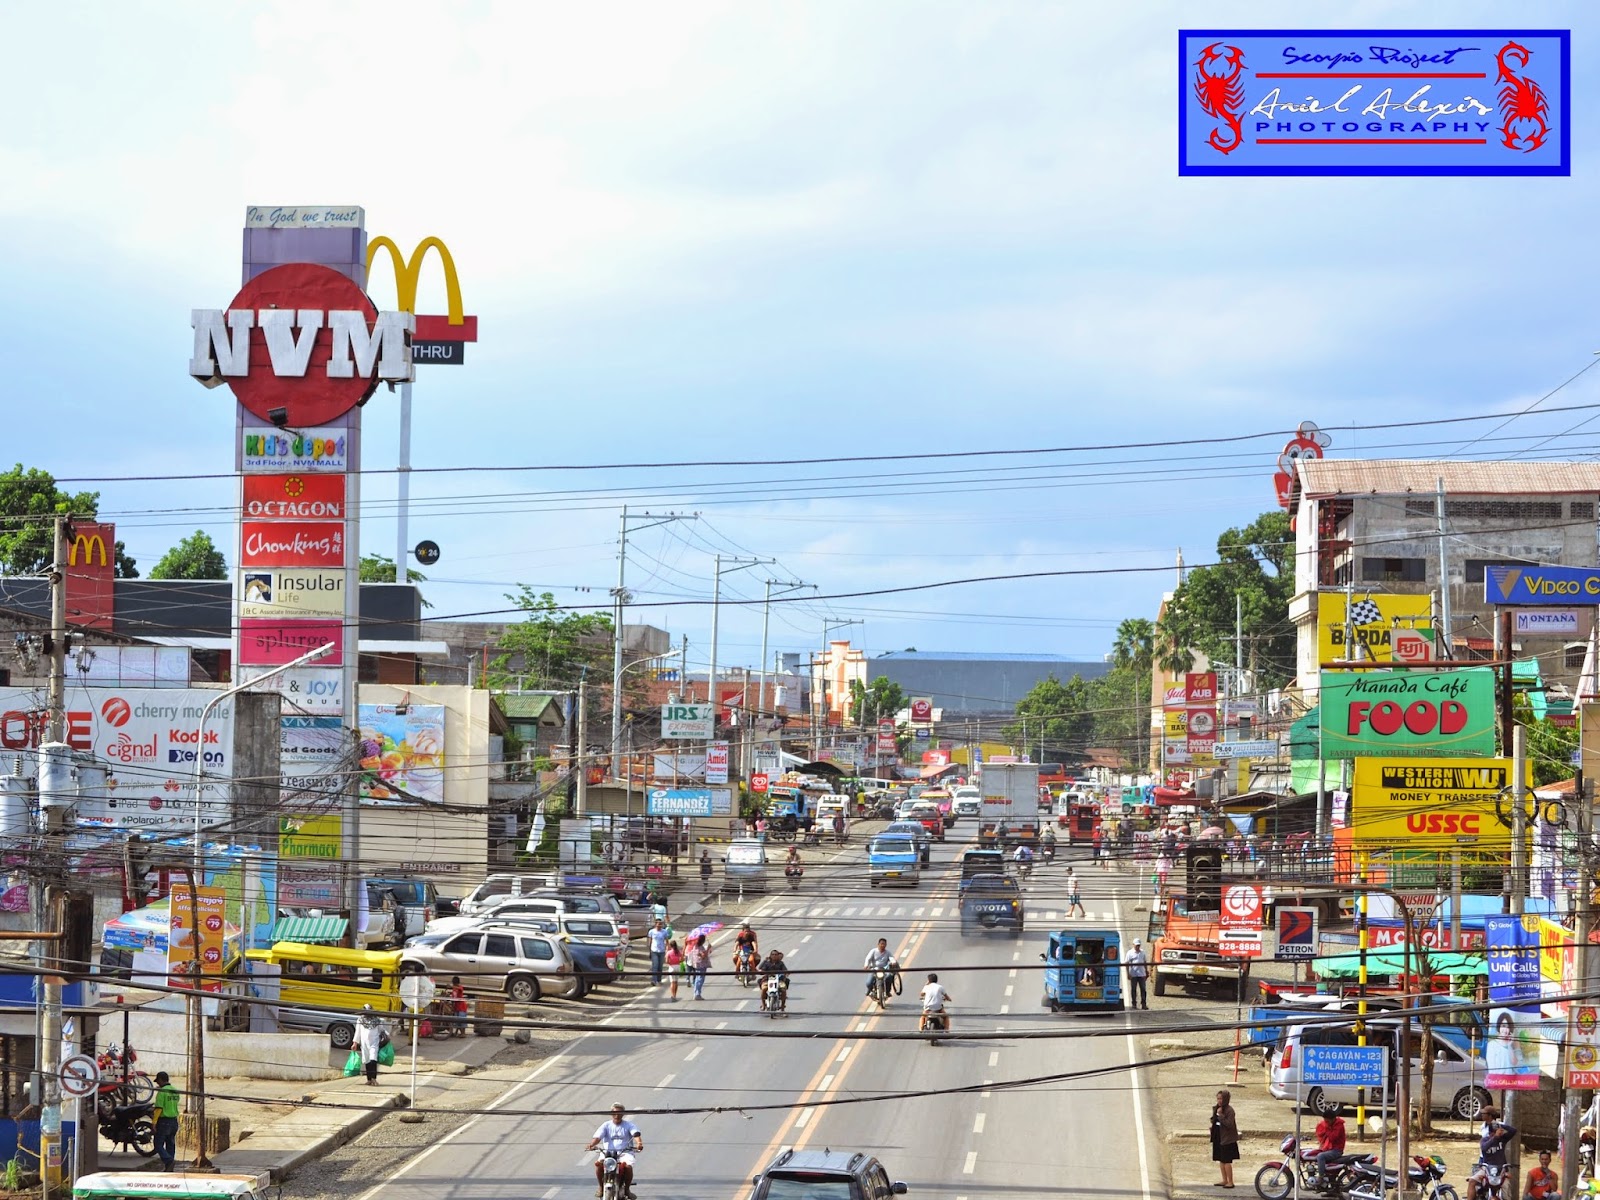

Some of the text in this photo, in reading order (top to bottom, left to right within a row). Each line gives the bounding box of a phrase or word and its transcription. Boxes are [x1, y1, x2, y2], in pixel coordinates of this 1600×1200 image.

[248, 207, 357, 228] In God we trust
[190, 309, 413, 378] NVM
[411, 345, 453, 358] THRU
[245, 435, 345, 460] Kid's depot
[248, 501, 340, 516] OCTAGON
[246, 532, 330, 556] Chowking
[278, 573, 344, 591] Insular
[278, 592, 300, 603] Life
[256, 629, 329, 653] splurge
[290, 680, 300, 692] &
[306, 681, 338, 696] JOY
[1190, 688, 1212, 698] AUB
[1345, 677, 1469, 698] Manada Café
[134, 702, 178, 721] cherry
[662, 706, 699, 720] JRS
[1347, 700, 1468, 736] FOOD
[668, 722, 707, 731] EXPRESS
[106, 733, 157, 762] cignal
[707, 752, 728, 765] Amiel
[1384, 768, 1500, 788] WESTERN WU
[1405, 778, 1453, 788] UNION
[119, 799, 138, 808] iPad
[165, 800, 181, 808] LG
[651, 797, 709, 809] FERNANDEZ
[1390, 793, 1431, 801] MONEY
[127, 815, 164, 825] Polaroid
[1407, 814, 1480, 834] USSC
[282, 837, 338, 857] Pharmacy
[402, 863, 459, 872] ENTRANCE
[1403, 873, 1435, 883] PHOTO
[1278, 945, 1314, 953] PETRON
[1490, 944, 1499, 958] 3
[1501, 944, 1538, 958] DAYS
[1304, 1072, 1317, 1080] SN.
